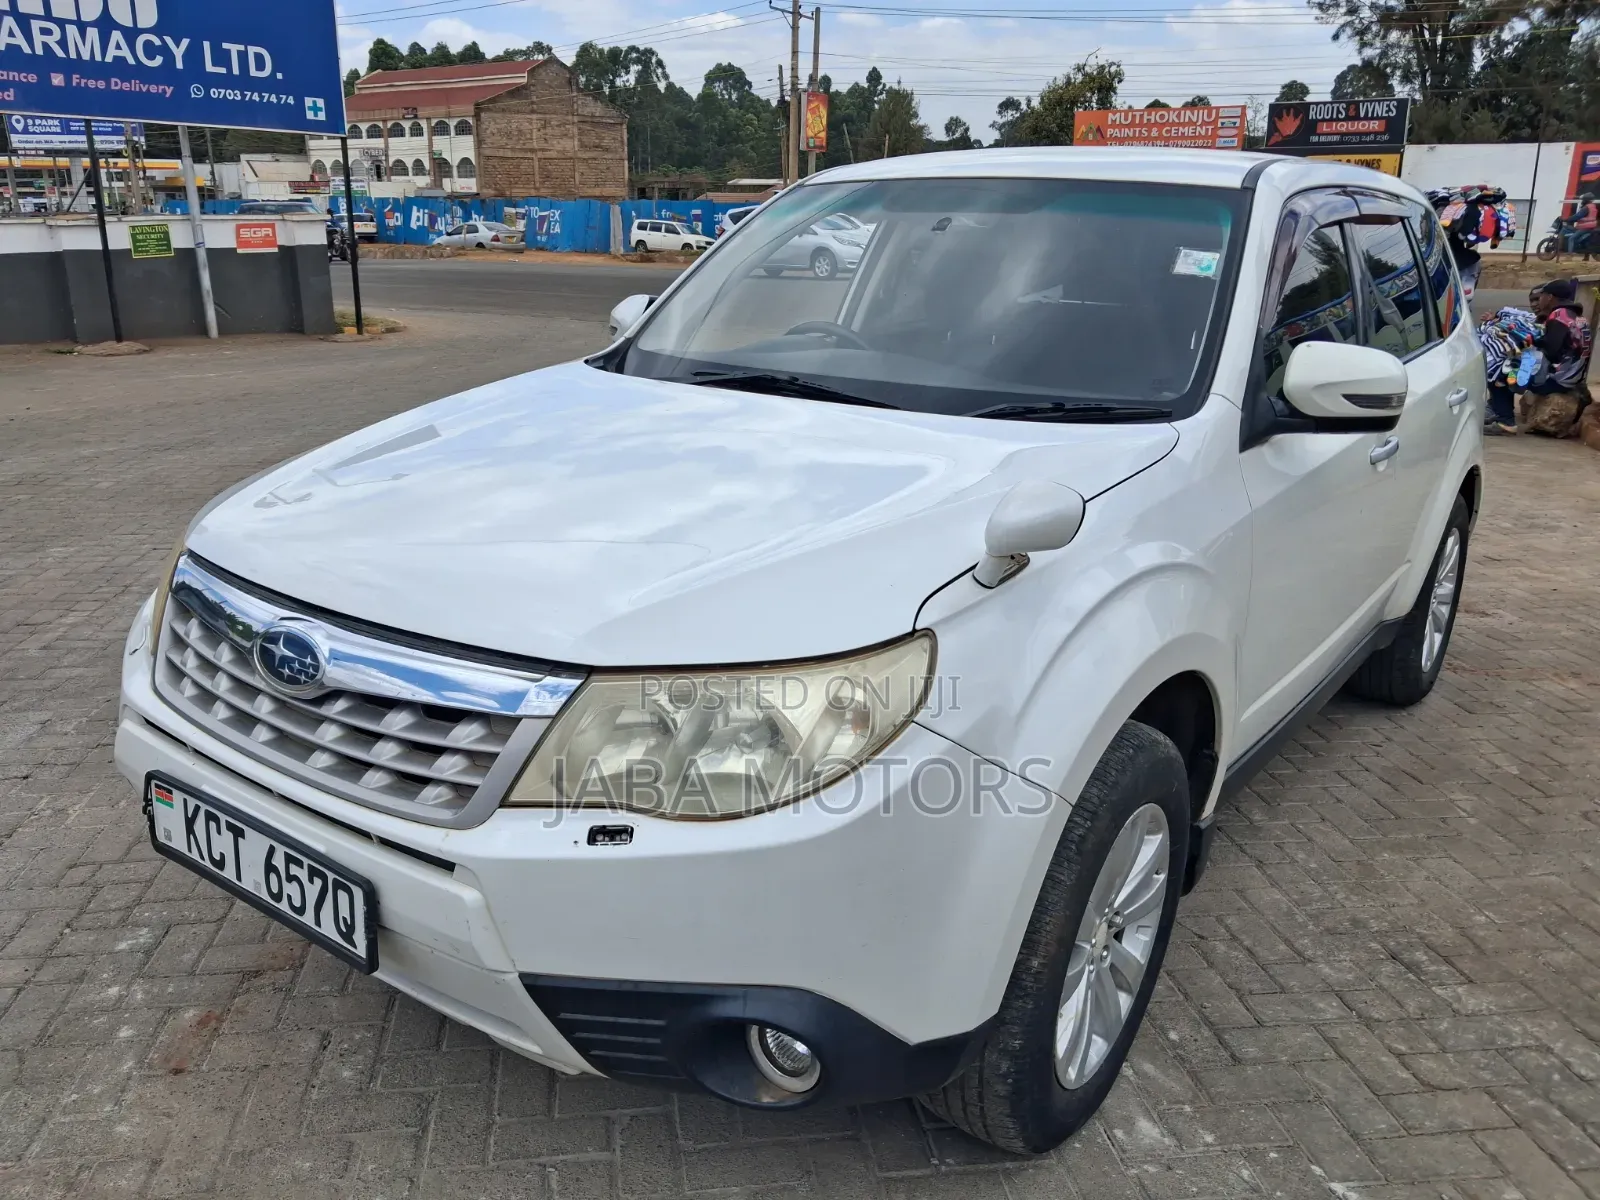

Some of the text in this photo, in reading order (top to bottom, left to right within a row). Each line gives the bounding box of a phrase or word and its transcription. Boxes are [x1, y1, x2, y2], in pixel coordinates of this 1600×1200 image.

[203, 41, 283, 80] LTD.
[72, 74, 106, 89] Free
[111, 77, 174, 98] Delivery
[210, 88, 241, 100] 0703
[1108, 108, 1217, 125] MUTHOKINJU
[1309, 101, 1397, 120] ROOTS & VYNES
[1107, 126, 1148, 138] PAINTS
[1151, 126, 1159, 137] &
[1162, 125, 1214, 137] CEMENT
[1323, 121, 1379, 131] LIQUOR
[1361, 134, 1374, 142] 248
[1376, 133, 1390, 141] 236
[130, 225, 169, 233] LAVINGTON
[239, 227, 273, 238] SGA
[183, 797, 358, 950] KCT 657Q
